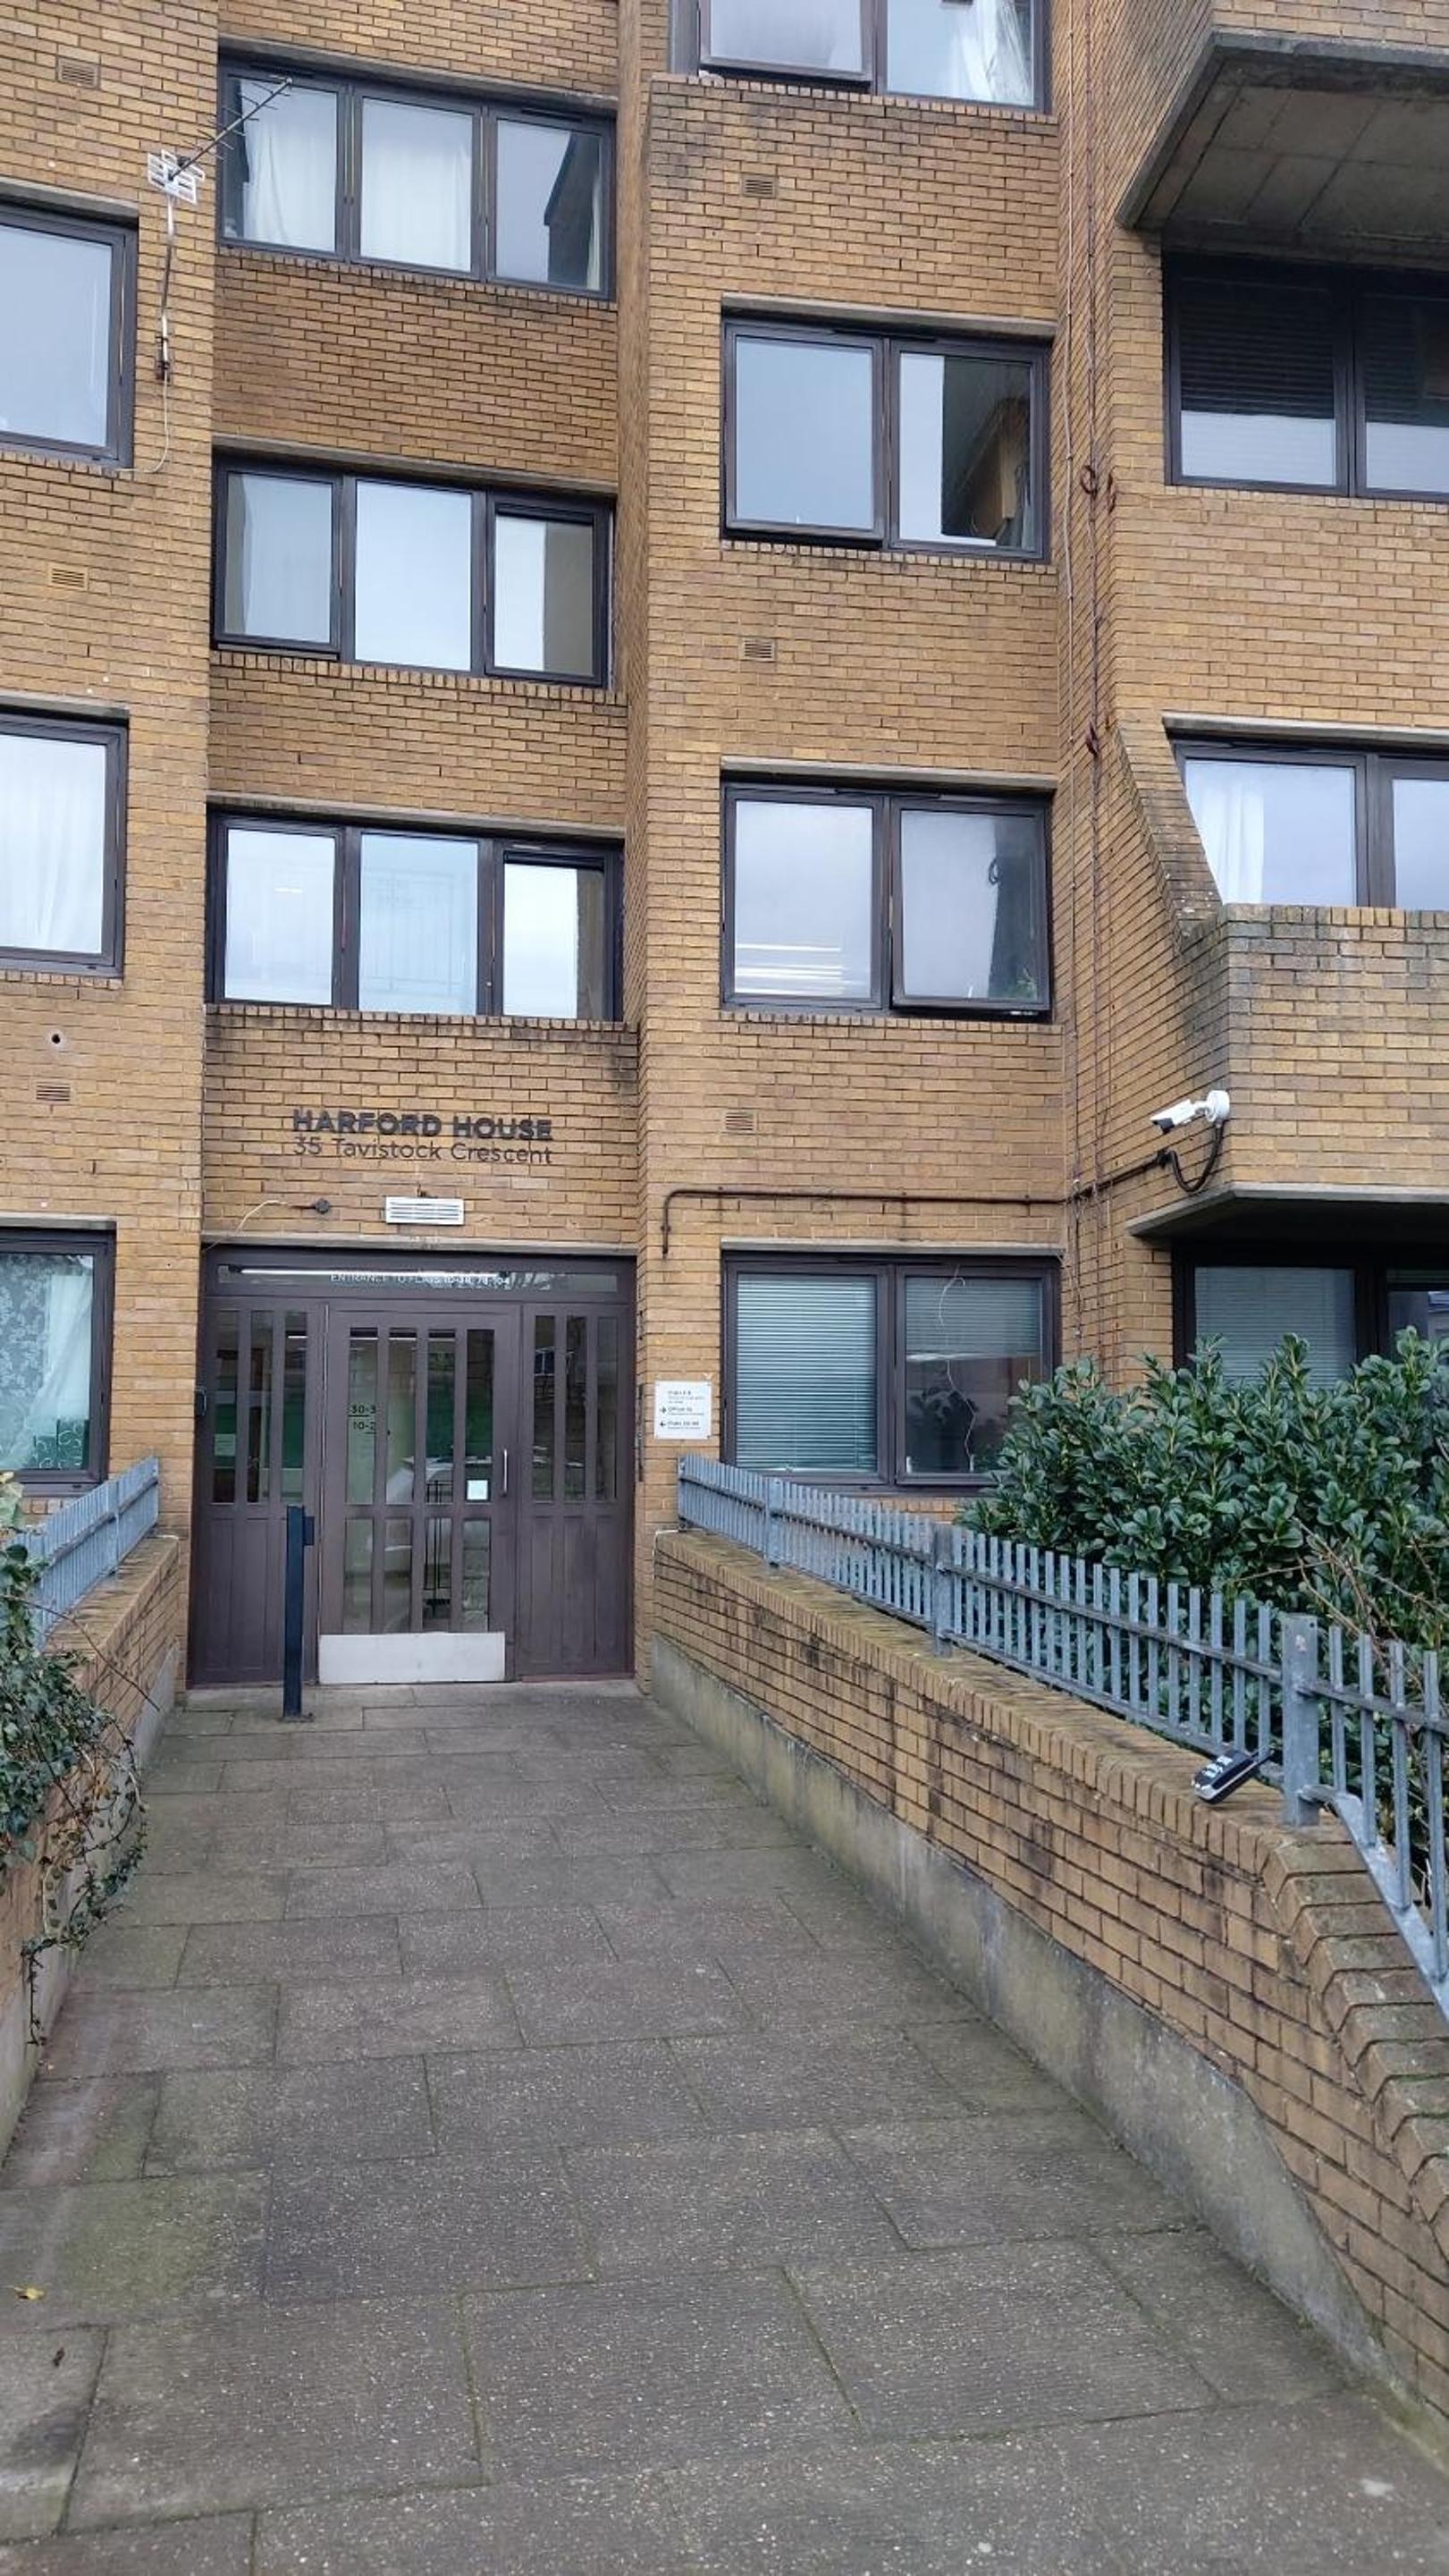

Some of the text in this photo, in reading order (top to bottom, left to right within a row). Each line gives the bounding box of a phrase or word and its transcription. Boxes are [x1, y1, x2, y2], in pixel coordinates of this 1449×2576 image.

[293, 1109, 553, 1140] HARFORD HOUSE
[293, 1136, 554, 1164] 35 Tavistock Crescent
